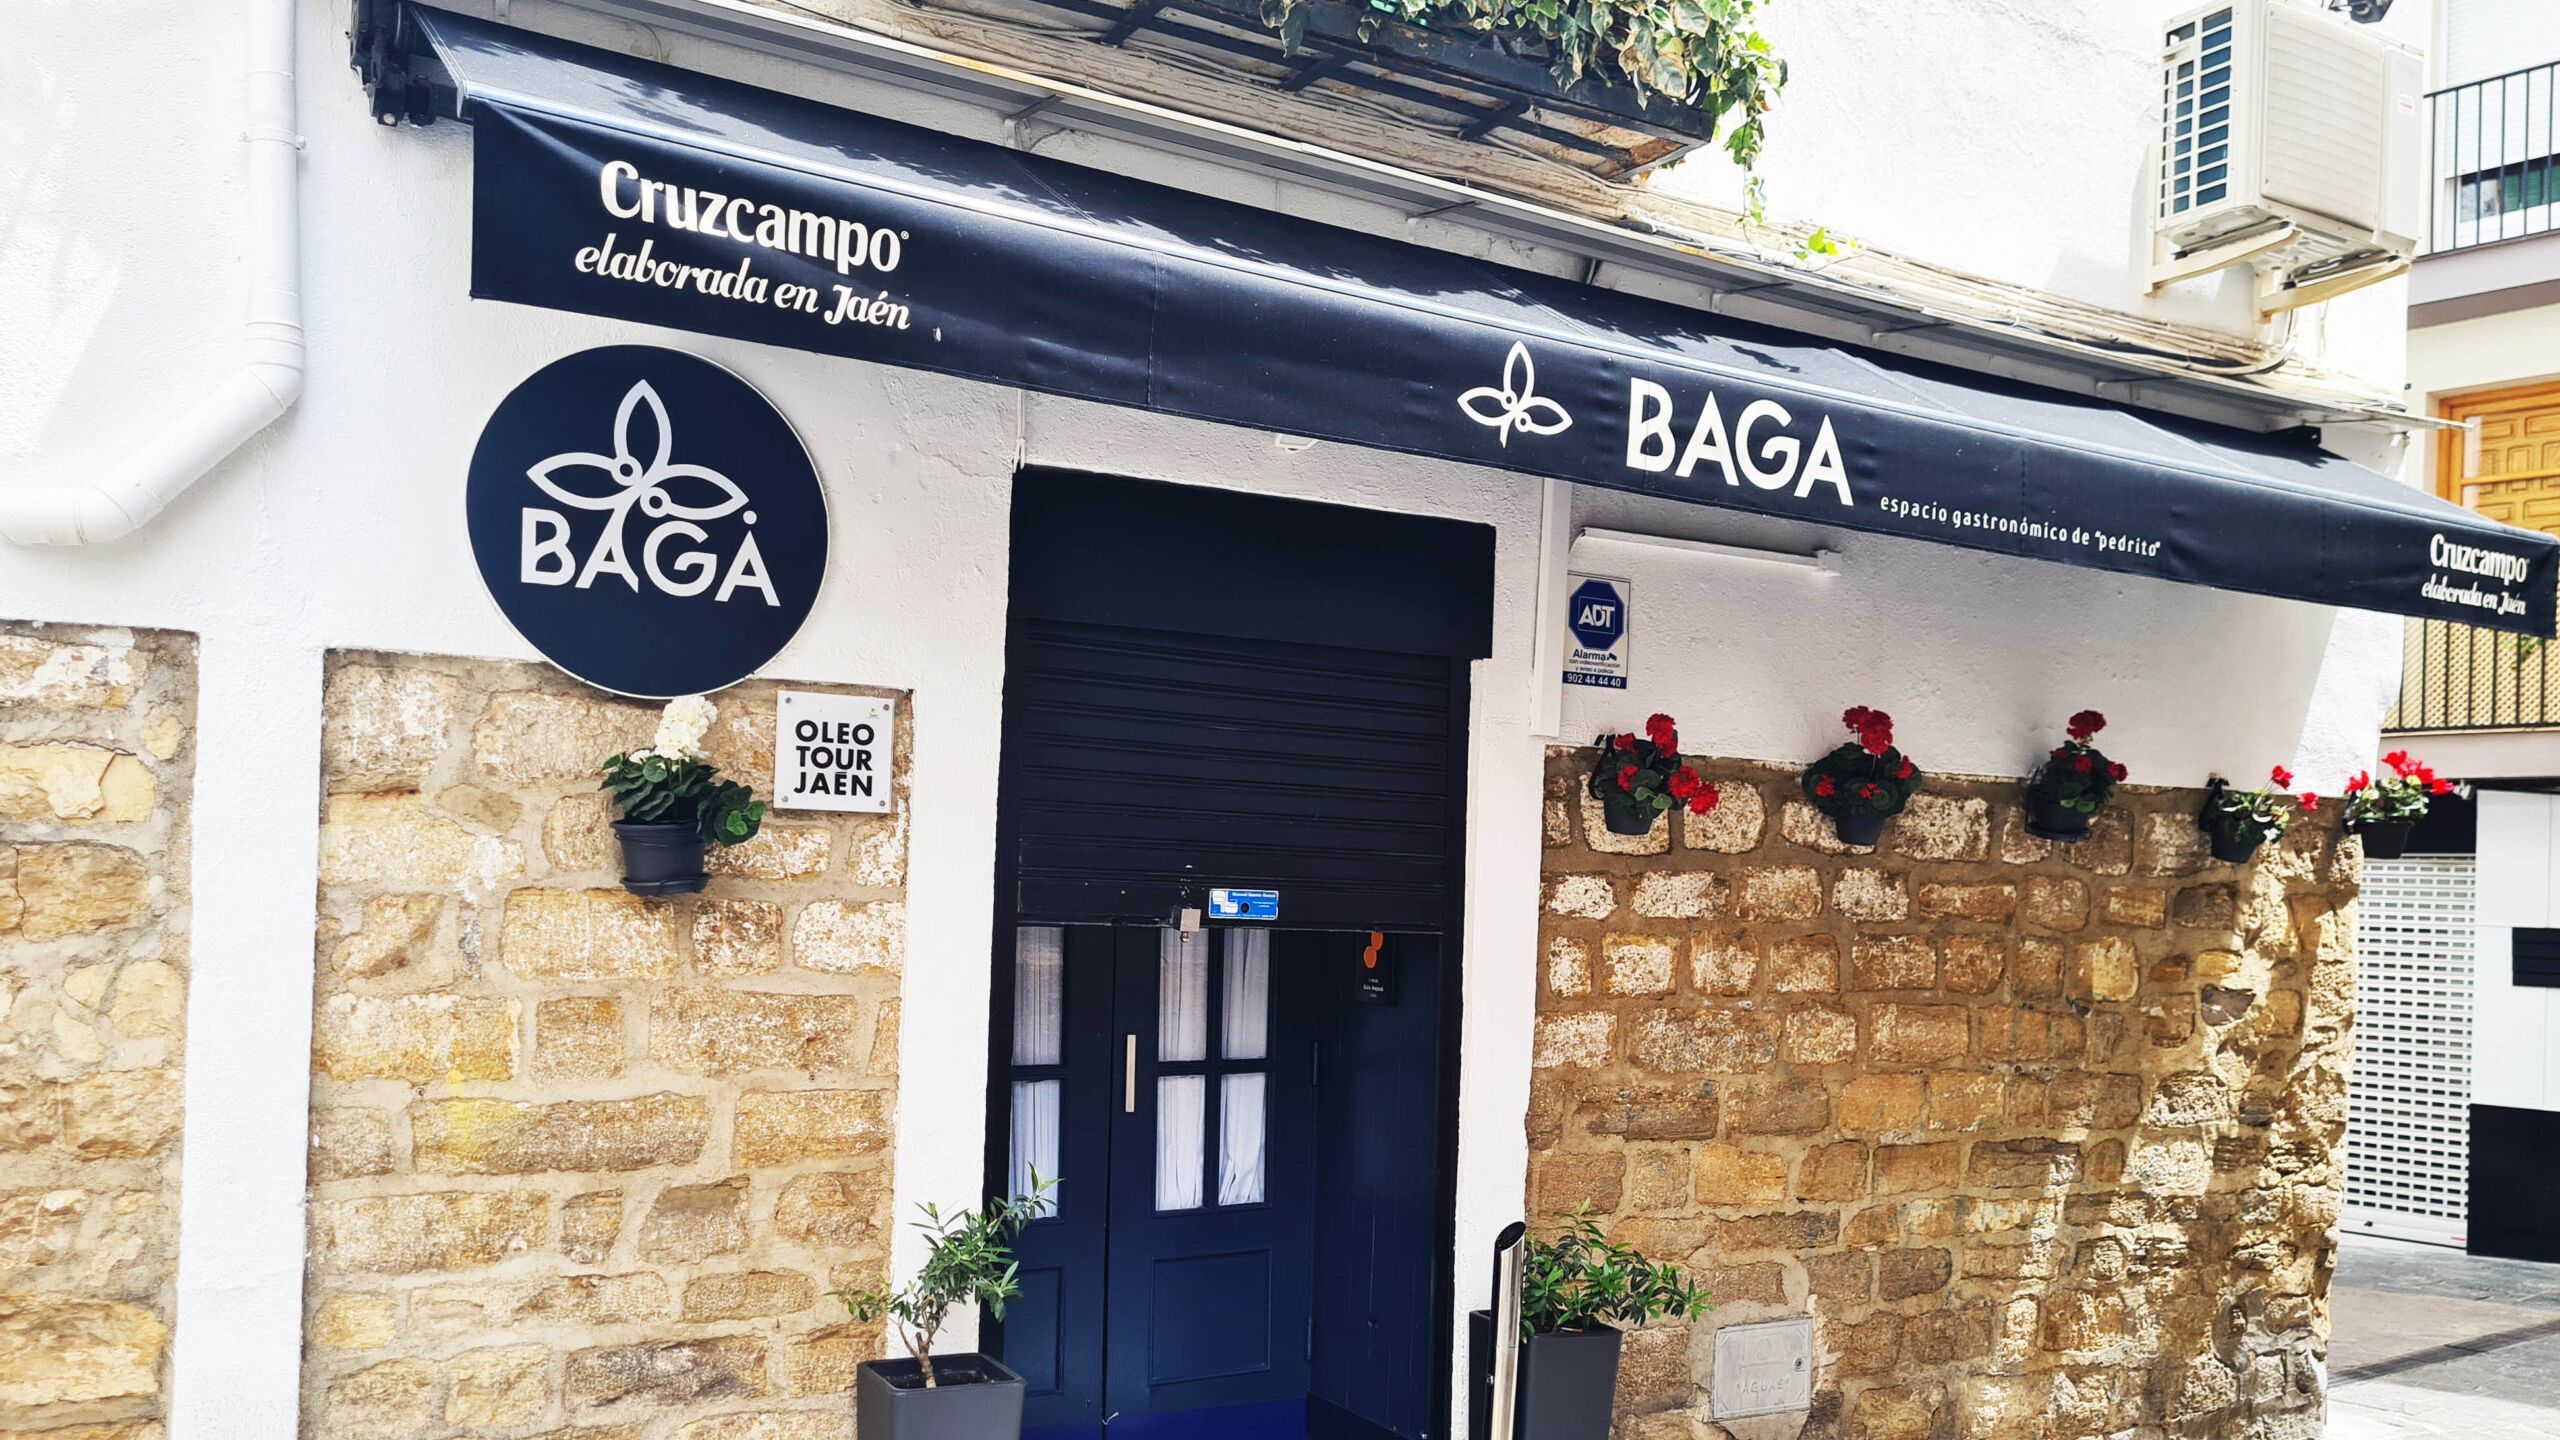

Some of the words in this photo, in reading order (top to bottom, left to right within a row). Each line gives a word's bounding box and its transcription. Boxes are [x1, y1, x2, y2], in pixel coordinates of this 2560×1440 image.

[574, 233, 768, 305] elaborada
[773, 282, 818, 313] en
[824, 285, 911, 330] Jaén
[1626, 377, 1854, 506] BAGA
[1880, 496, 1948, 522] espacio
[1952, 510, 2068, 541] gastronómico
[2071, 527, 2090, 546] de
[2429, 533, 2527, 586] Cruzcampo
[2421, 573, 2483, 606] elaborada
[2483, 592, 2498, 609] en
[2497, 591, 2526, 615] Jaén
[1578, 604, 1616, 628] ADT
[1573, 649, 1607, 660] Alarma
[1567, 673, 1583, 683] 902
[1585, 675, 1596, 684] 44
[1598, 676, 1609, 685] 44
[1610, 678, 1621, 687] 40
[795, 720, 875, 746] OLEO
[795, 746, 873, 771] TOUR
